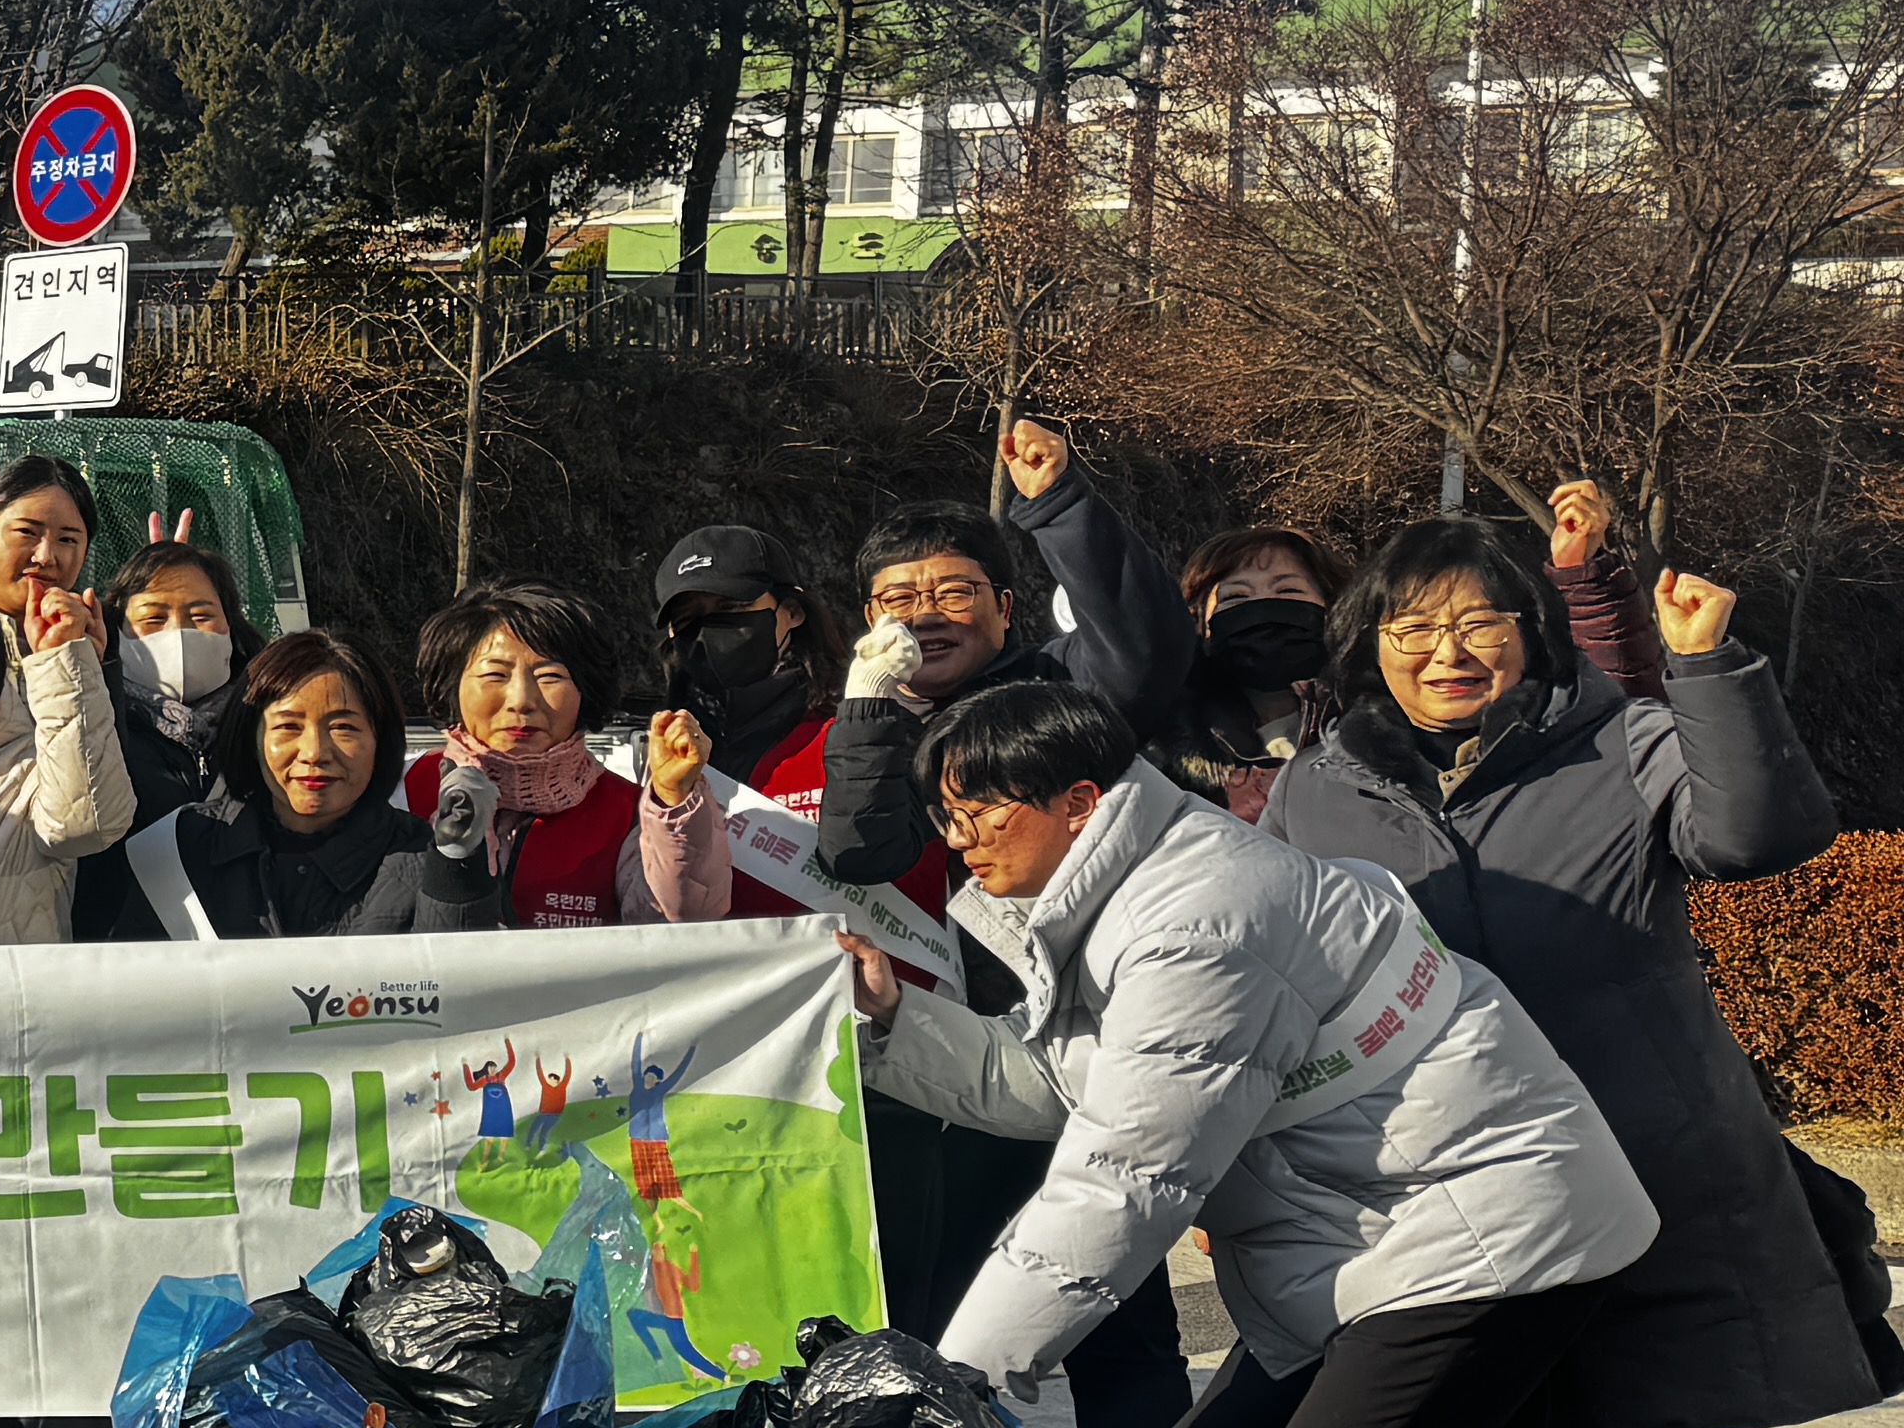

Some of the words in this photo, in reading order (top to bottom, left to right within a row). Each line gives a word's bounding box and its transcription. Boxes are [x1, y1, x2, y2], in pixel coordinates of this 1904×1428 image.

[31, 152, 116, 182] 주정차금지
[13, 261, 117, 302] 견인지역
[749, 824, 801, 867] 함께
[545, 892, 597, 912] 옥련2동
[380, 982, 417, 993] Better
[420, 980, 439, 992] life
[1396, 946, 1441, 1013] 주민과
[292, 984, 440, 1027] Yeonsu
[1353, 1005, 1406, 1059] 함께
